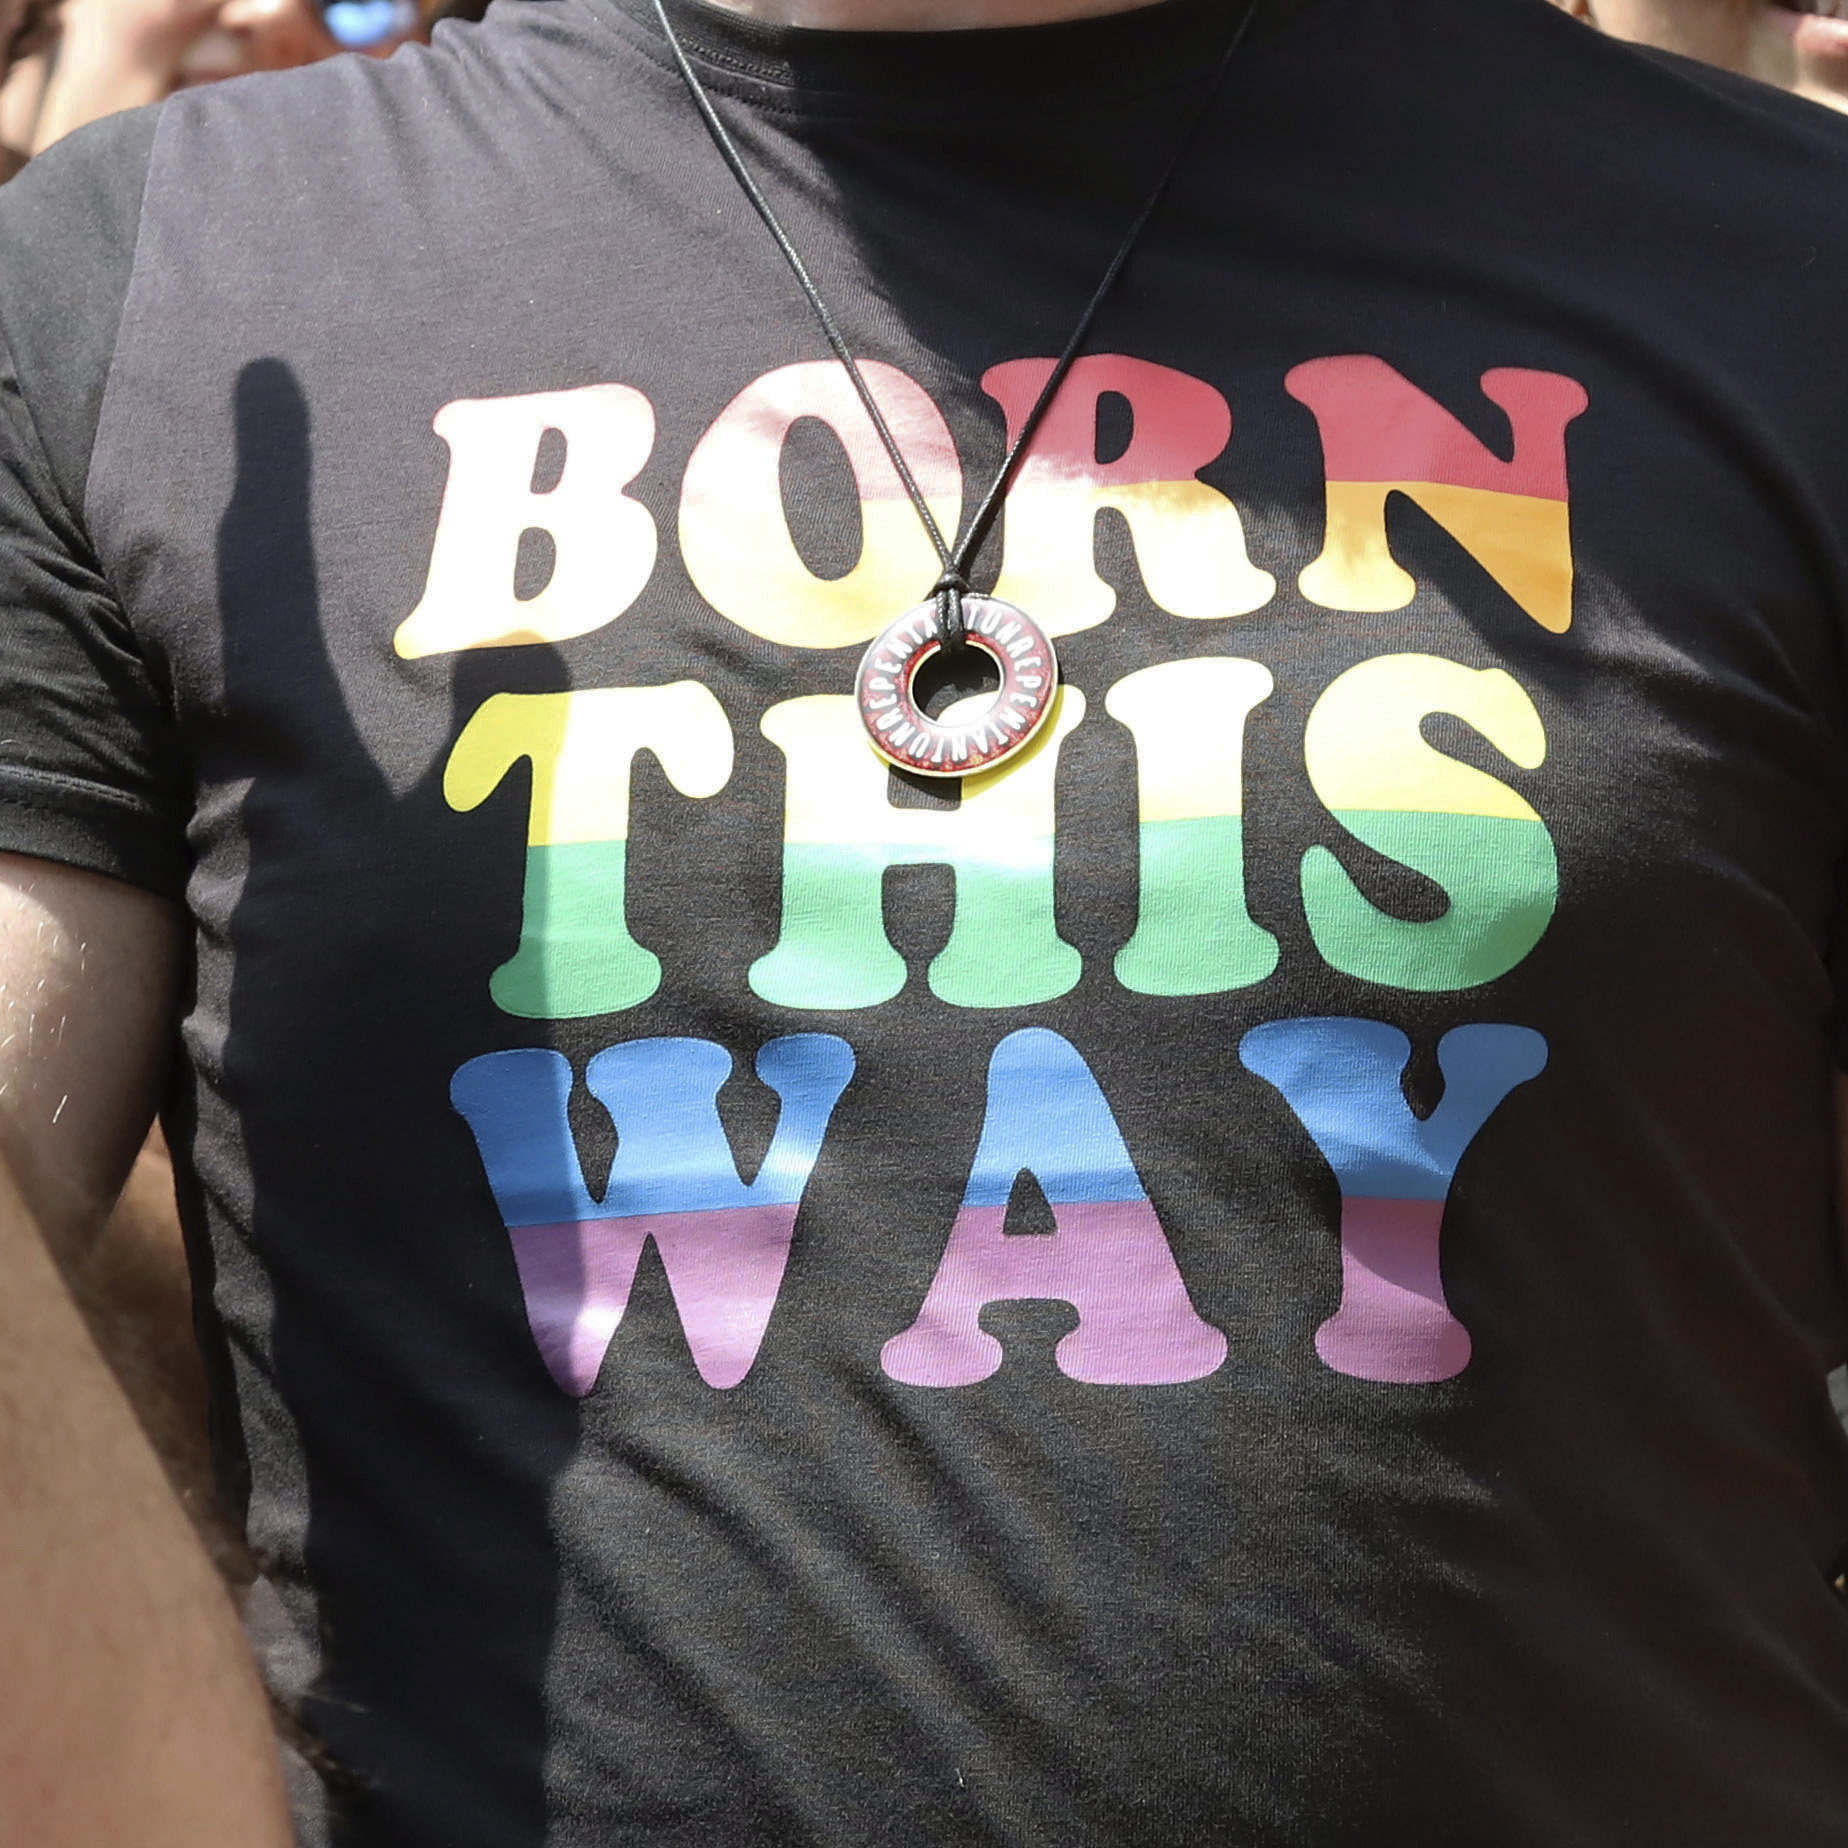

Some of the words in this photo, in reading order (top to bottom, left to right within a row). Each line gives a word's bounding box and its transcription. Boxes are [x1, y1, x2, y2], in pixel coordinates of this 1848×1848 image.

[395, 353, 1589, 659] BORN
[443, 653, 1560, 1019] THIS
[450, 1016, 1549, 1397] WAY
